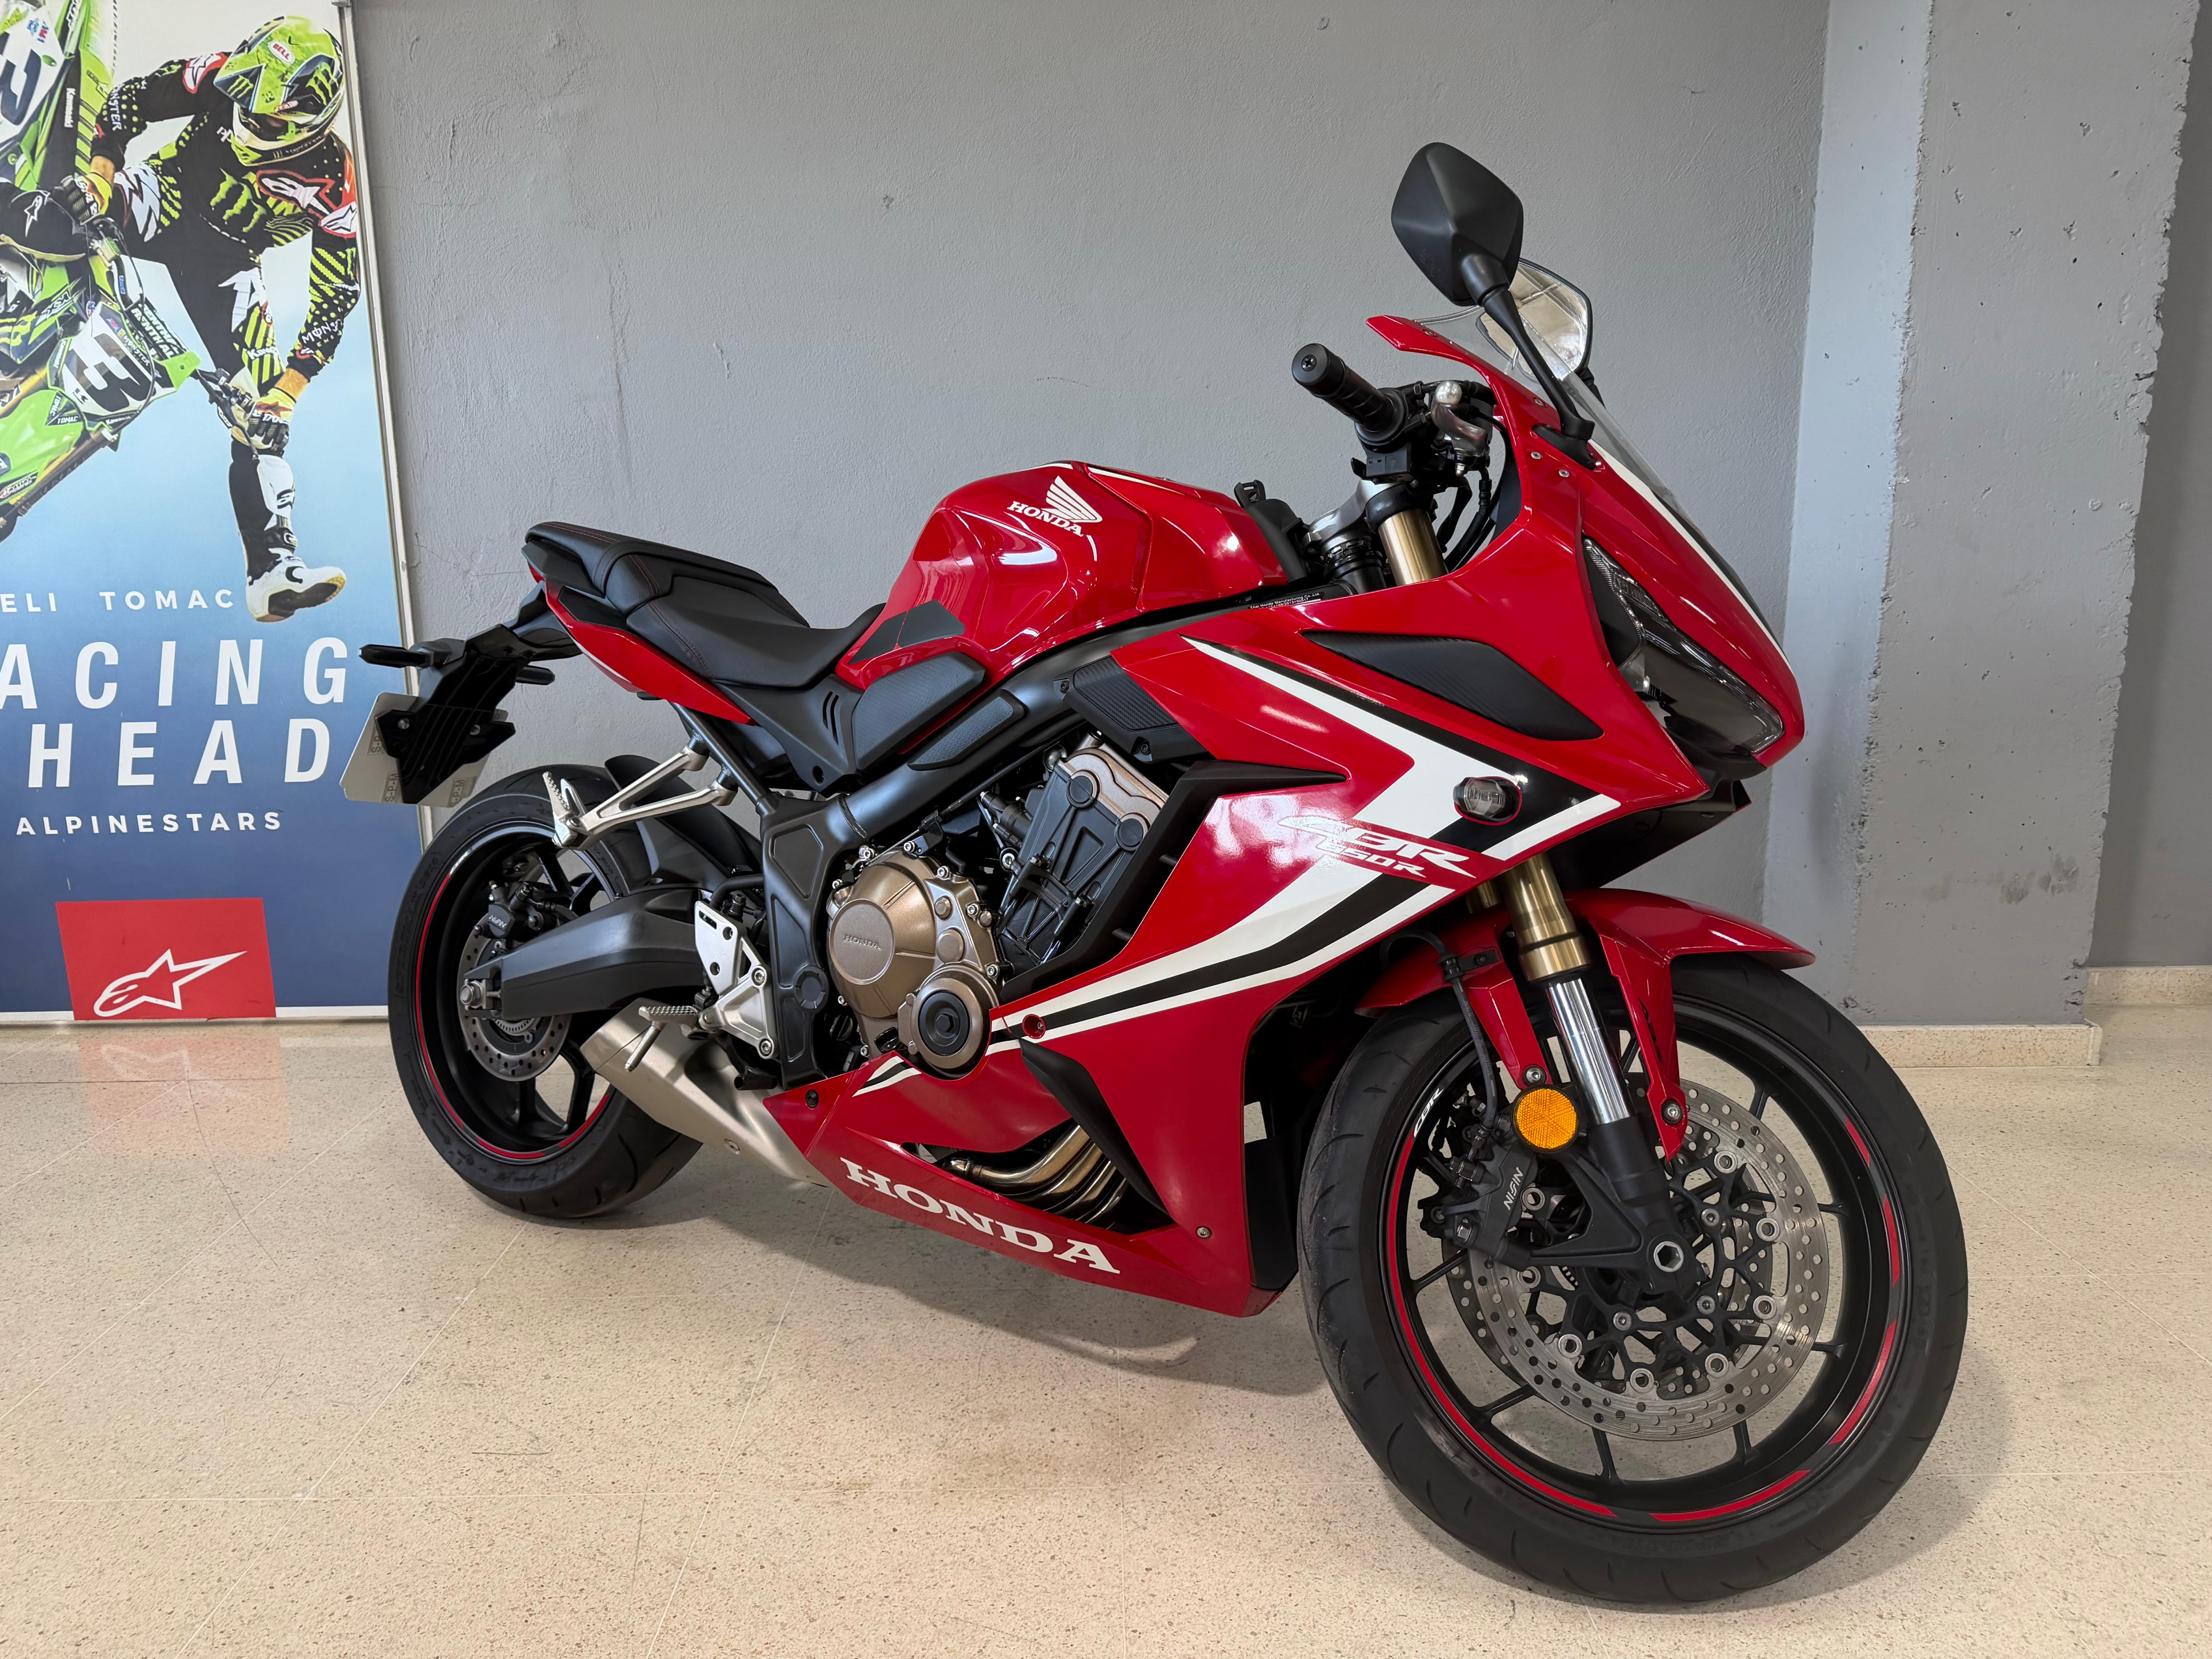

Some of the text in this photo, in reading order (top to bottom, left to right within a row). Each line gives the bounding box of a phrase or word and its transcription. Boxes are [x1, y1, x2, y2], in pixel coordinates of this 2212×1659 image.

[273, 43, 290, 60] BELL
[65, 333, 156, 413] 3
[49, 395, 61, 416] TOMAC
[57, 415, 78, 425] TOMAC
[1007, 501, 1084, 537] HONDA
[0, 589, 233, 613] ELI TOMAC
[28, 718, 330, 788] HEAD
[16, 812, 281, 835] ALPINESTARS
[843, 934, 881, 950] HONDA
[1414, 1087, 1444, 1138] CBR
[1503, 1167, 1523, 1211] NISSIN
[839, 1157, 1121, 1275] HONDA
